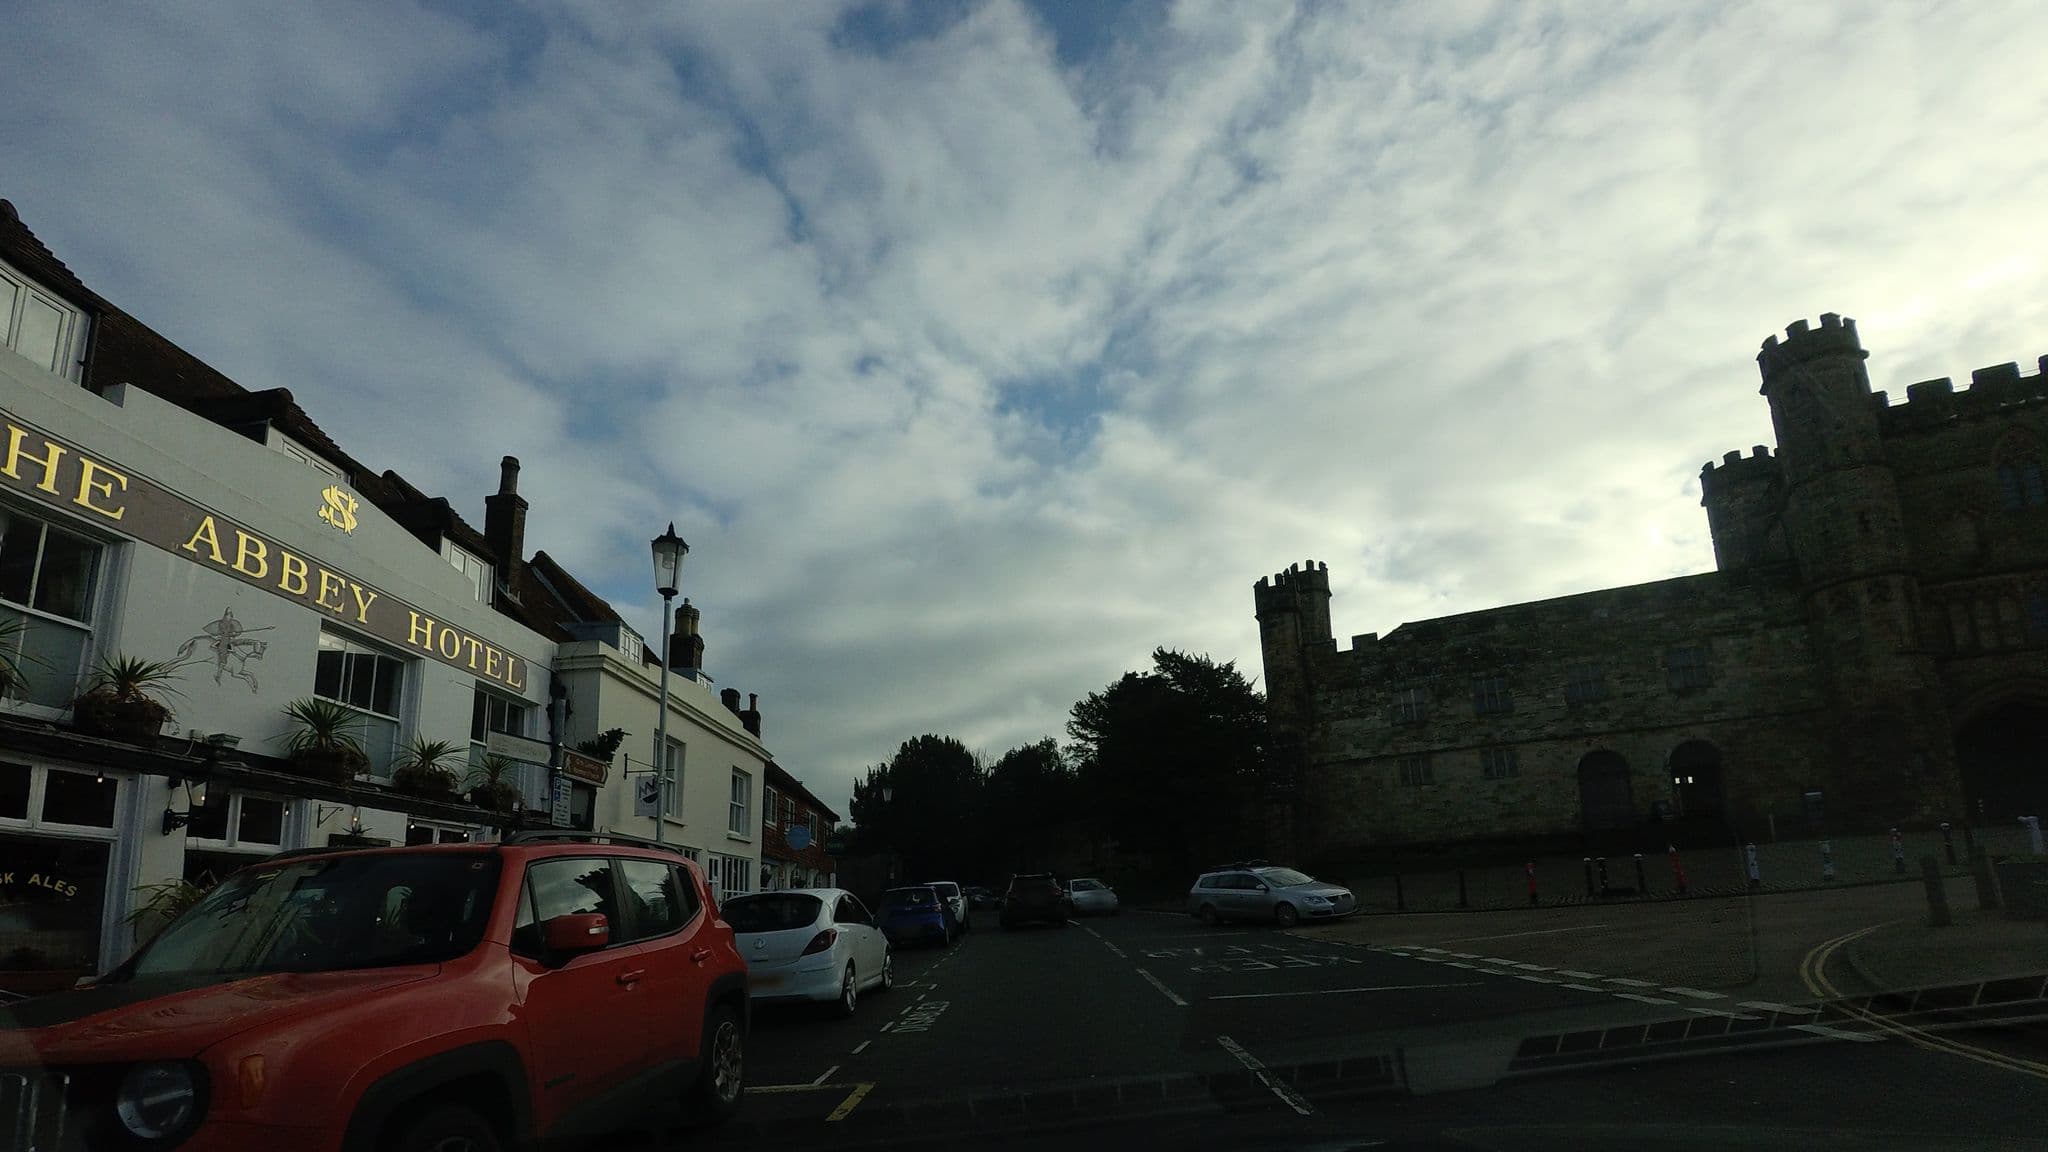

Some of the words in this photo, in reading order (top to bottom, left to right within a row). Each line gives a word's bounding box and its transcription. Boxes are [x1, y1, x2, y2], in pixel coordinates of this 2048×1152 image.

[182, 515, 378, 625] ABBEY
[407, 610, 522, 688] HOTEL
[28, 873, 78, 897] ALES
